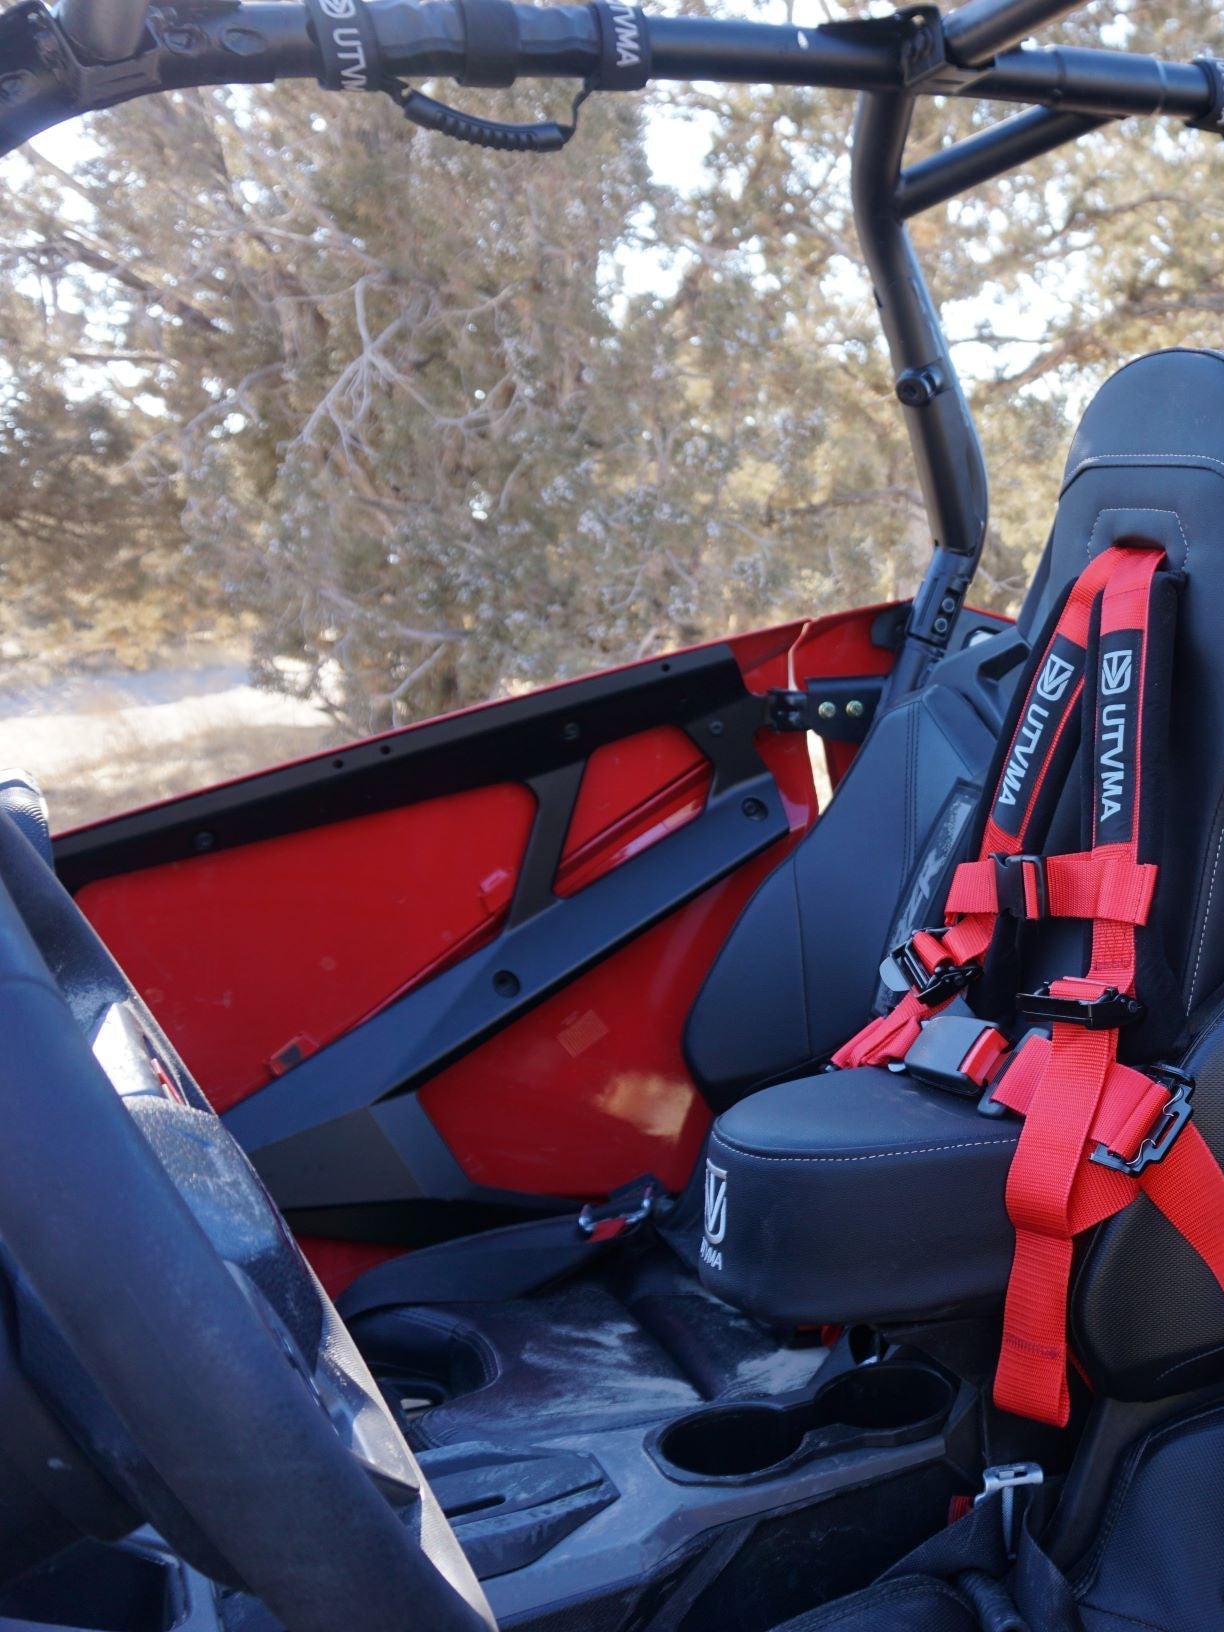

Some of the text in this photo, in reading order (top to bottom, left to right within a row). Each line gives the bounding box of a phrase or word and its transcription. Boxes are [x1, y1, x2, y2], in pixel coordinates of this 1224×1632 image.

[608, 3, 641, 67] TVMA
[998, 703, 1050, 806] UTVMA
[1099, 703, 1127, 823] UTVMA
